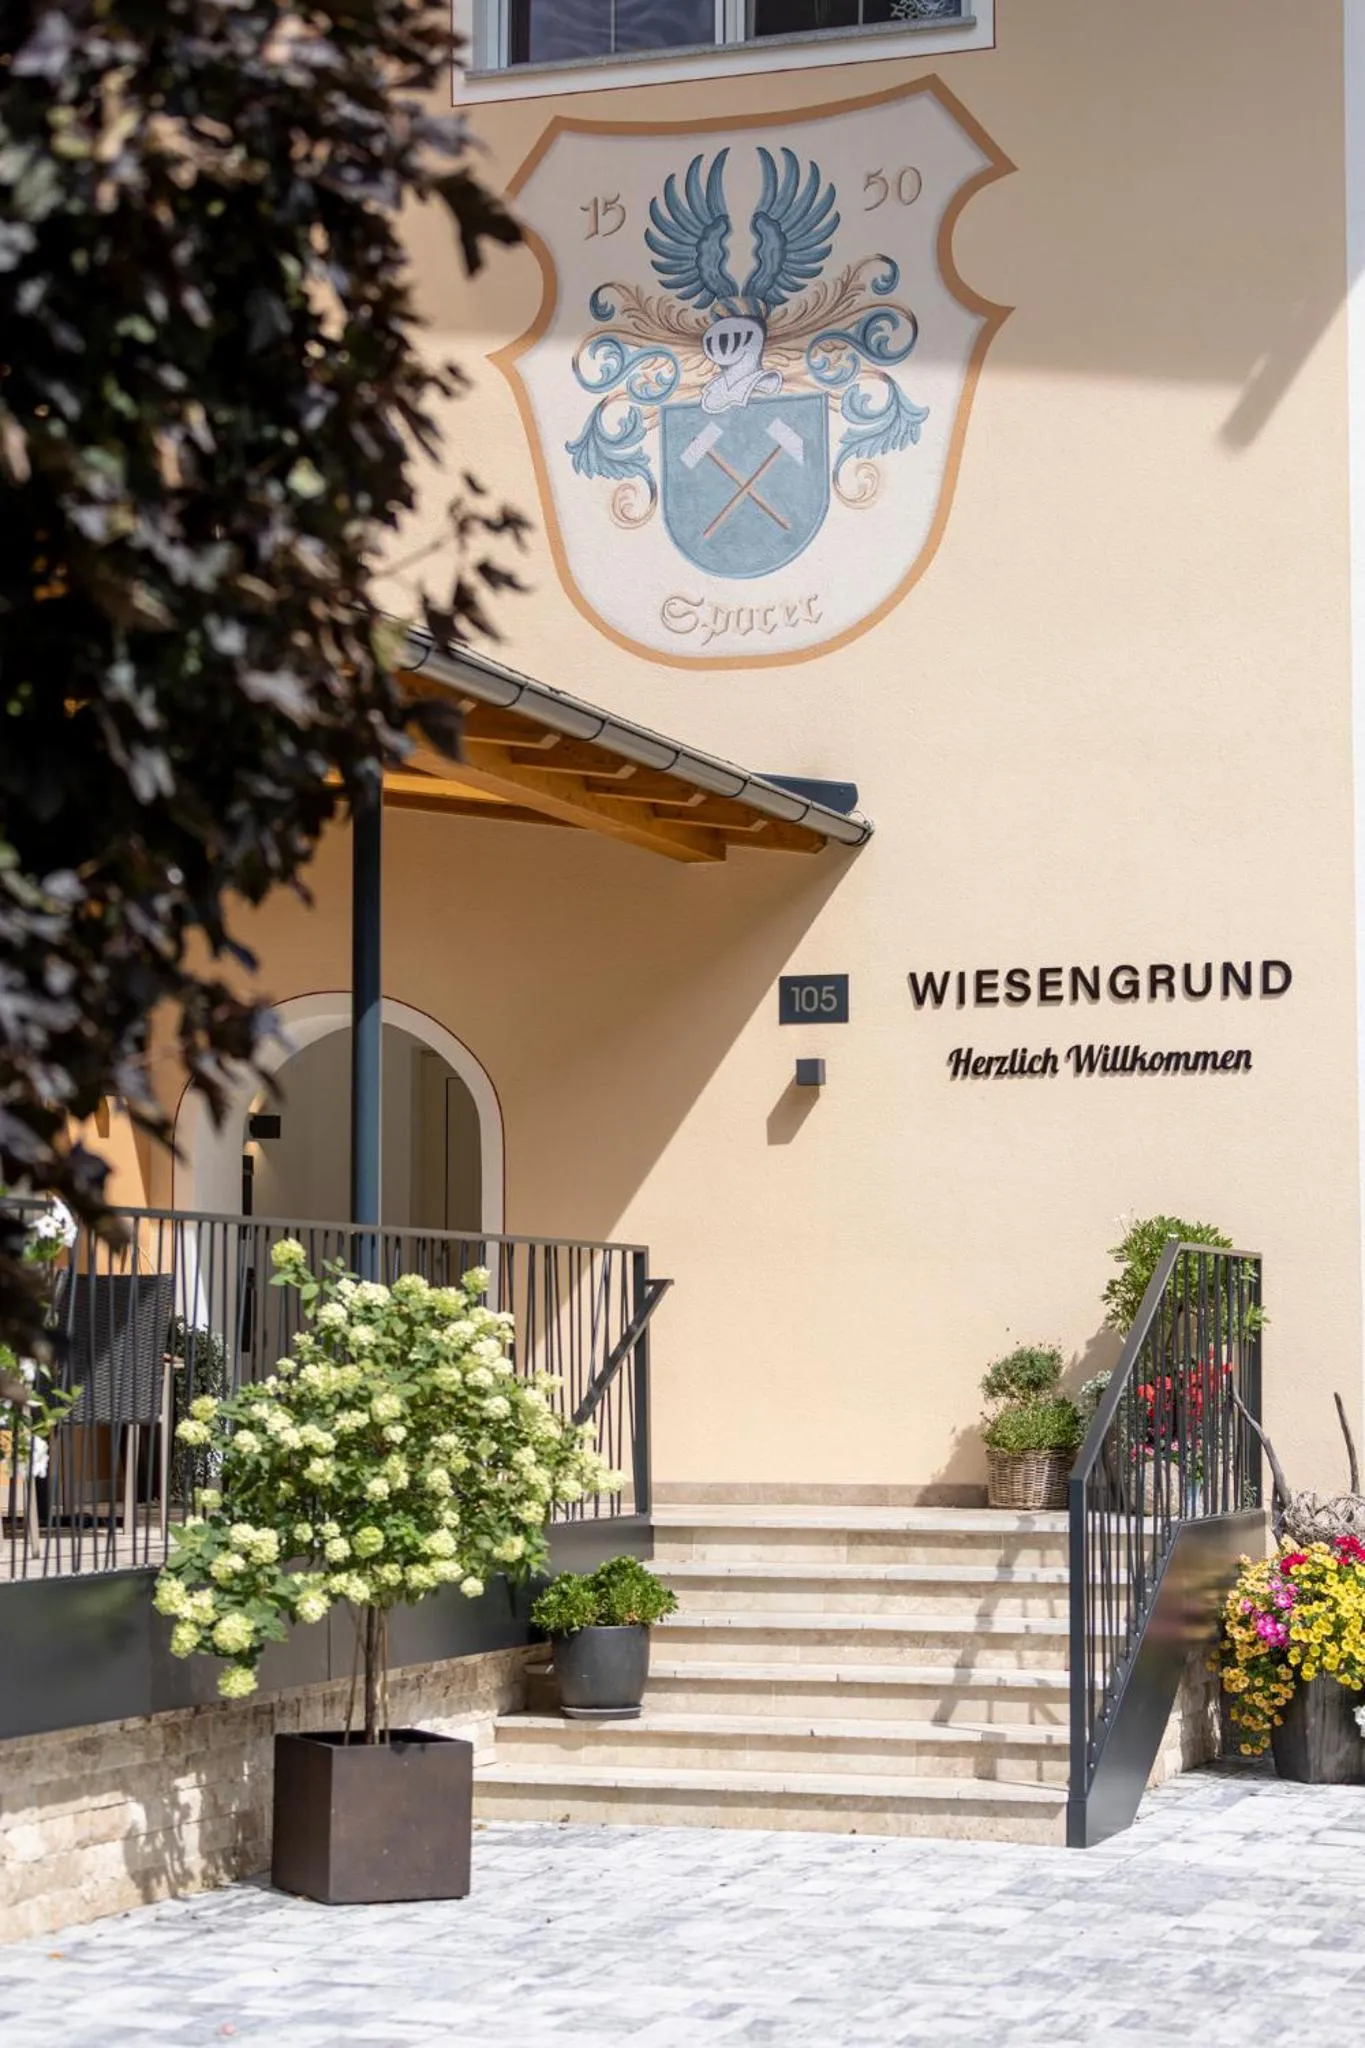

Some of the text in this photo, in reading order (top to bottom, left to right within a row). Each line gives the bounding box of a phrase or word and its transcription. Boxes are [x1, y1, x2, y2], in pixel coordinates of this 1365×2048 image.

[579, 166, 923, 241] 15 50
[790, 985, 838, 1013] 105
[908, 959, 1293, 1008] WIESENGRUND
[948, 1043, 1253, 1078] Herzlich Willkommen
